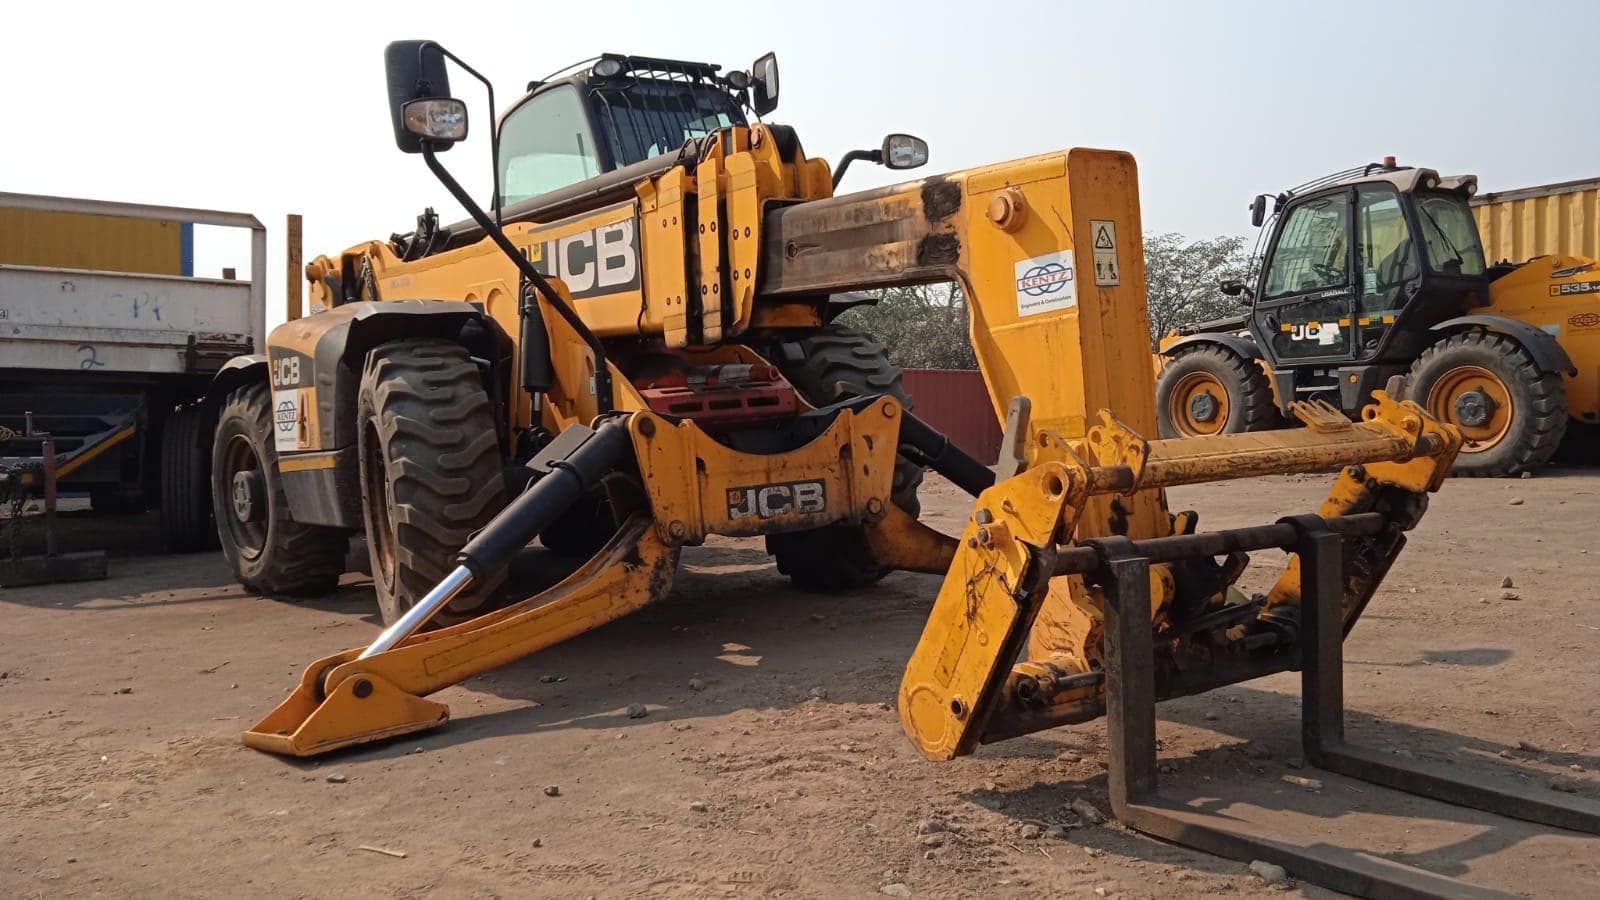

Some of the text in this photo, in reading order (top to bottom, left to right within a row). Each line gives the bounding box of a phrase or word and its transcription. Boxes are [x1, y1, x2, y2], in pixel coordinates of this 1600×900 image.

[1022, 271, 1068, 288] KENTZ
[1291, 322, 1339, 341] JC
[273, 357, 300, 387] JCB
[729, 482, 825, 520] JCB
